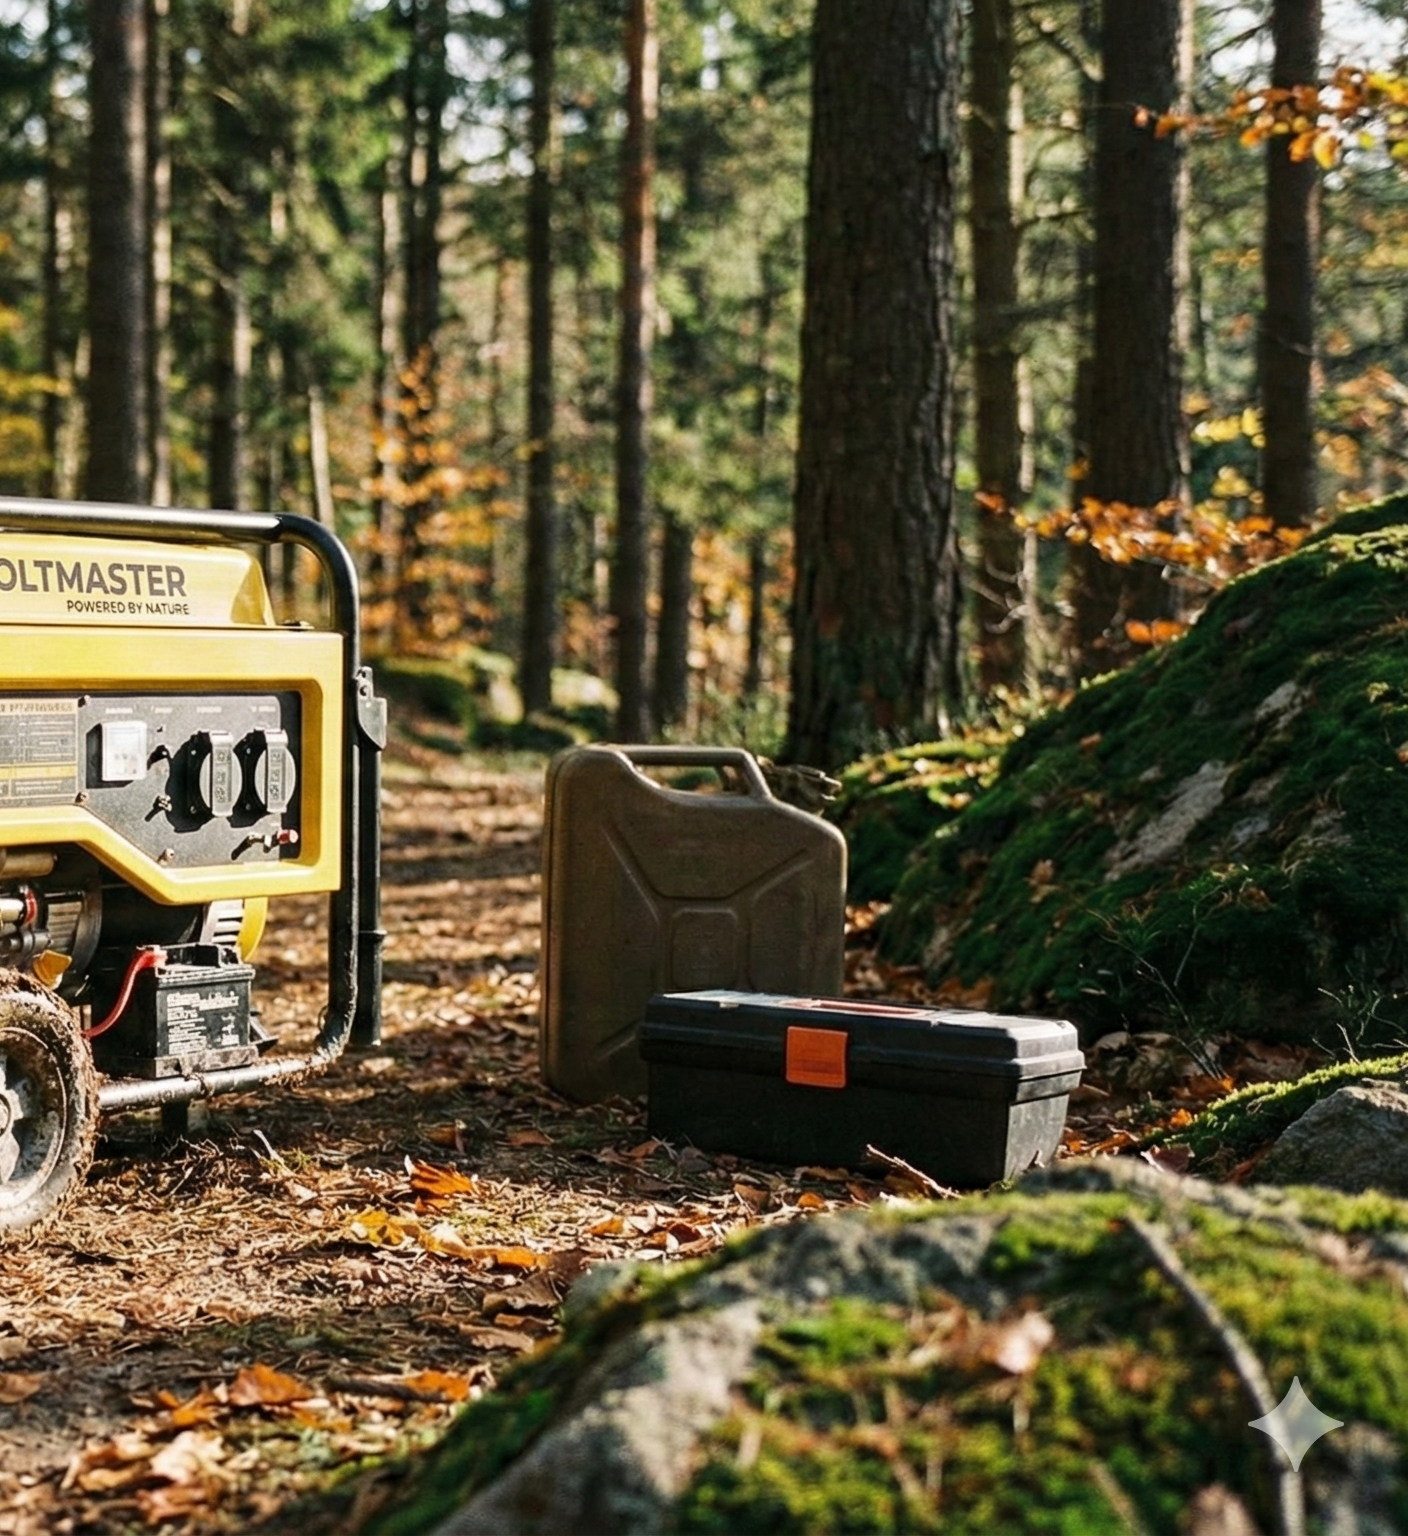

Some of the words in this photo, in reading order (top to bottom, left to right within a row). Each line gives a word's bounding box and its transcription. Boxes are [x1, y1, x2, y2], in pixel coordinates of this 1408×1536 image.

[66, 600, 126, 614] POWERED
[128, 602, 144, 614] BY
[145, 603, 190, 616] NATURE
